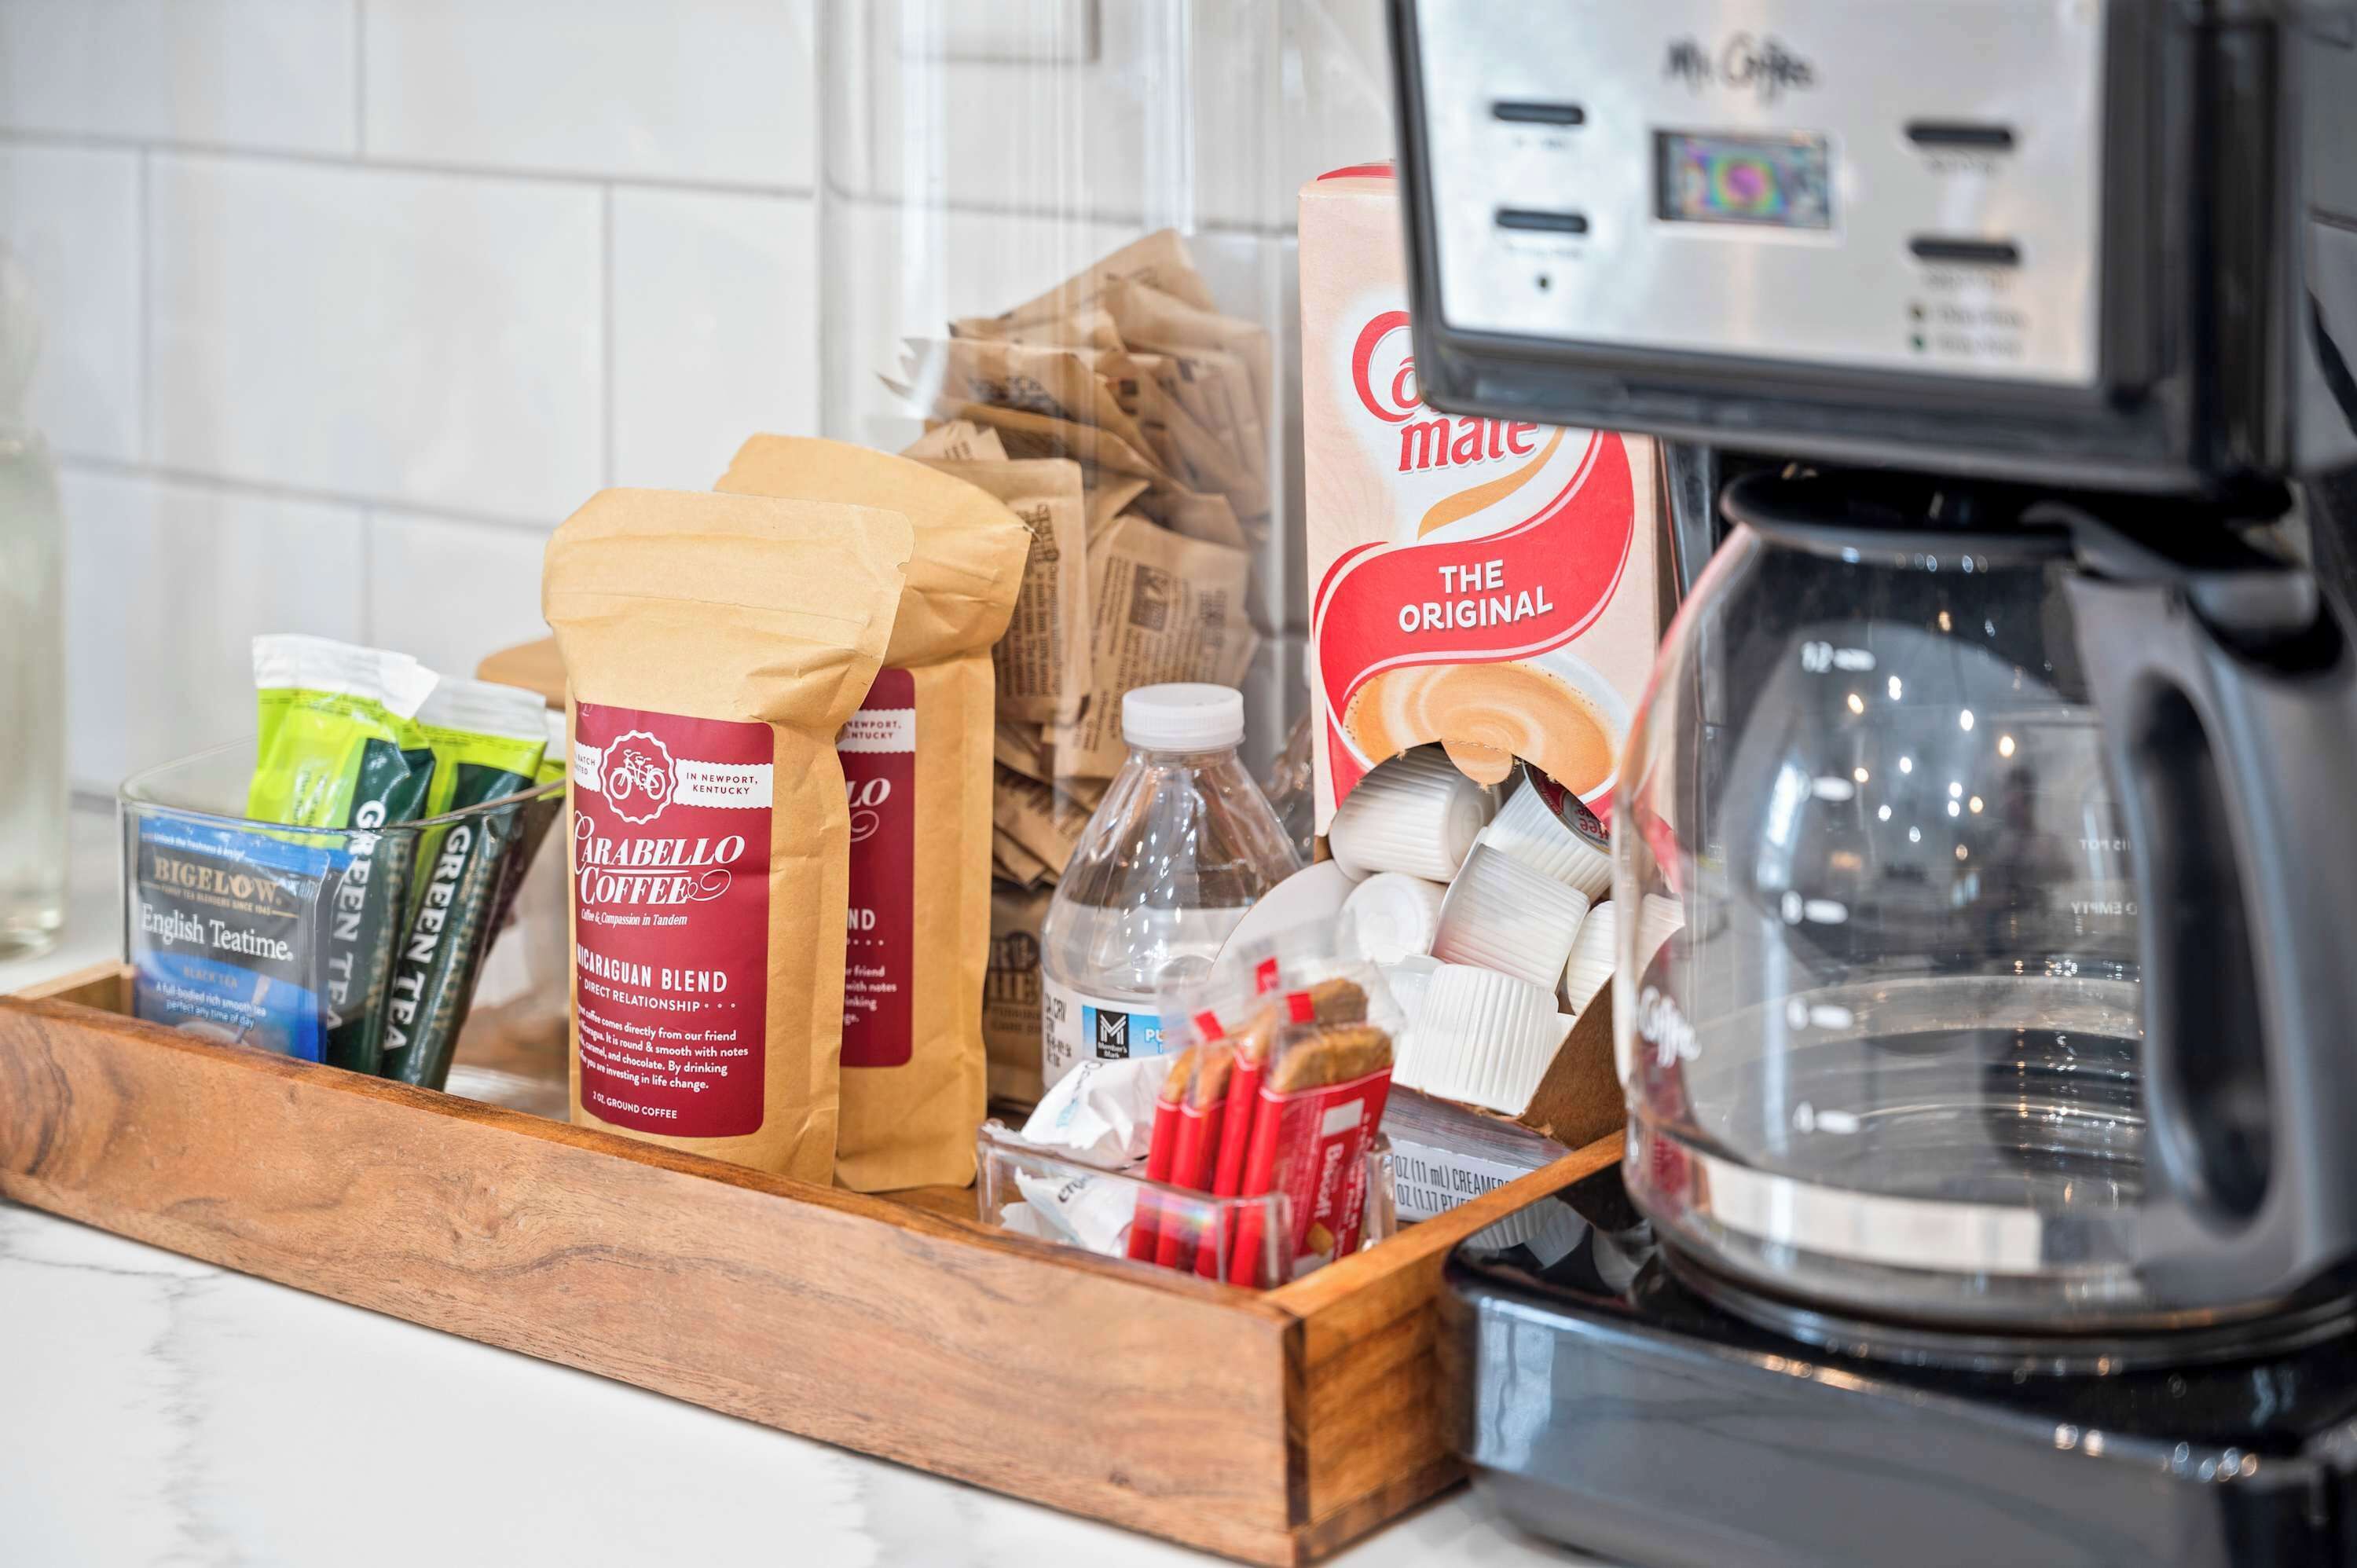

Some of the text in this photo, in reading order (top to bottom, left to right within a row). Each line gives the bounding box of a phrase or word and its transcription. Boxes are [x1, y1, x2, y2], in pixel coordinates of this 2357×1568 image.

[1398, 417, 1538, 471] mate
[1439, 559, 1505, 594] THE
[1398, 585, 1553, 632] ORIGINAL
[686, 772, 758, 785] IN NEWPORT,
[692, 784, 750, 795] KENTUCKY
[405, 825, 471, 963] GREEN
[141, 903, 205, 945] English
[326, 800, 386, 1030] GREEN TEA
[581, 908, 688, 929] Coffee & Compassion in Tandem
[577, 943, 728, 993] NICARAGUAN BLEND
[206, 992, 221, 1006] rich
[222, 998, 252, 1013] smooth
[383, 971, 425, 1050] TEA
[584, 980, 701, 1013] DIRECT RELATIONSHIP
[211, 1008, 229, 1020] time
[239, 1015, 255, 1030] day
[602, 1018, 623, 1031] comes
[624, 1021, 657, 1040] directly
[658, 1027, 682, 1040] from
[684, 1032, 702, 1041] our
[705, 1030, 737, 1041] friend
[606, 1031, 611, 1044] It
[612, 1034, 619, 1046] is
[620, 1041, 643, 1052] round
[645, 1042, 654, 1053] &
[655, 1046, 692, 1057] smooth
[695, 1046, 717, 1057] with
[720, 1048, 749, 1057] notes
[1097, 1041, 1128, 1053] Member's
[1103, 1049, 1120, 1059] Mark
[585, 1042, 607, 1060] caramel,
[607, 1051, 621, 1062] and
[622, 1053, 665, 1071] chocolate.
[668, 1060, 681, 1075] By
[684, 1061, 728, 1077] drinking
[586, 1058, 596, 1069] you
[596, 1063, 606, 1074] are
[606, 1064, 640, 1086] investing
[641, 1073, 650, 1085] in
[651, 1074, 668, 1087] life
[669, 1076, 709, 1093] change.
[592, 1090, 597, 1101] 2
[607, 1097, 640, 1113] GROUND
[641, 1106, 678, 1119] COFFEE
[1395, 1155, 1409, 1179] OZ
[1396, 1183, 1412, 1207] OZ
